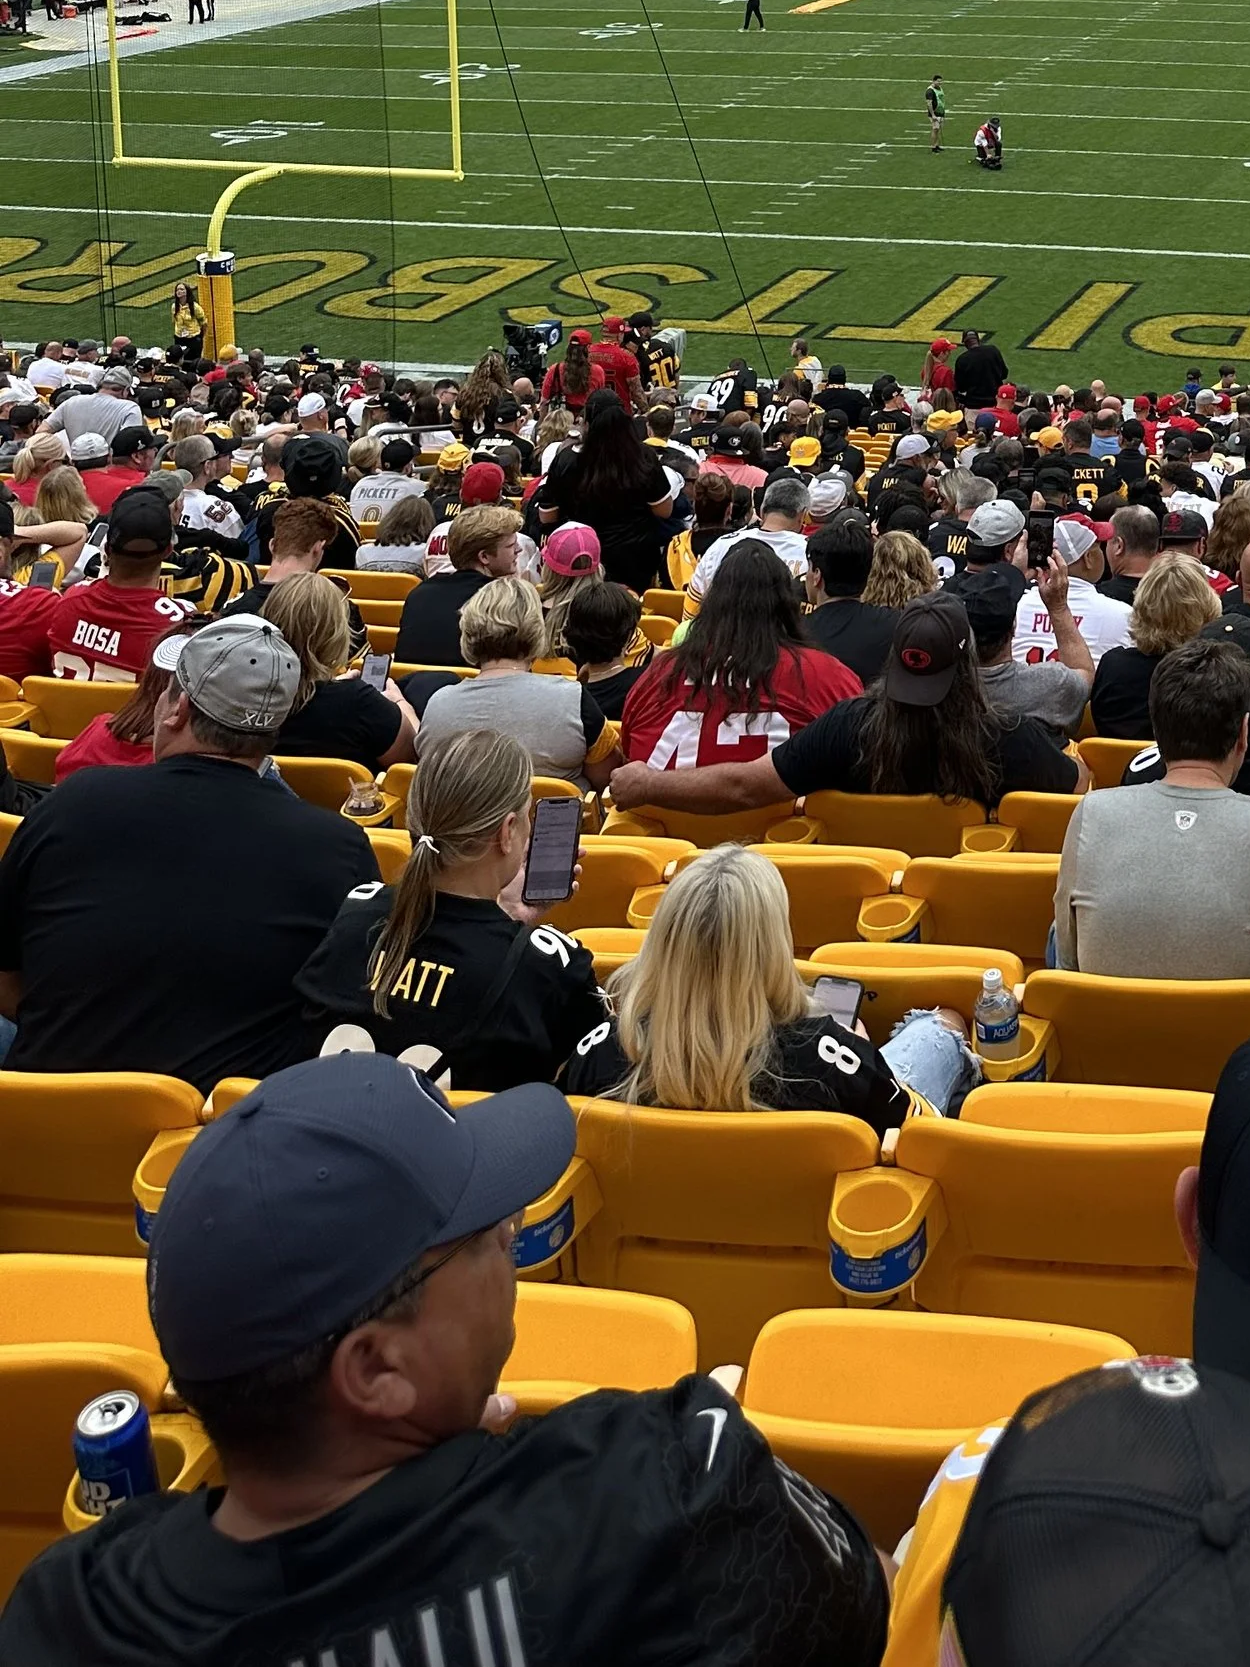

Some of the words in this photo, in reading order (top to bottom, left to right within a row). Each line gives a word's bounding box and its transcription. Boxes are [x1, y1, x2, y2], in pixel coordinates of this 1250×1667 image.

[709, 377, 735, 406] 39
[1071, 468, 1105, 480] CKETT
[359, 487, 399, 500] PICKETT
[445, 502, 462, 517] WA
[947, 534, 968, 555] WA
[1031, 612, 1084, 633] PUY
[72, 619, 122, 657] BOSA
[240, 710, 275, 728] XLV
[576, 1020, 612, 1057] 8
[992, 1021, 1017, 1039] AQUAF
[815, 1033, 864, 1079] 8
